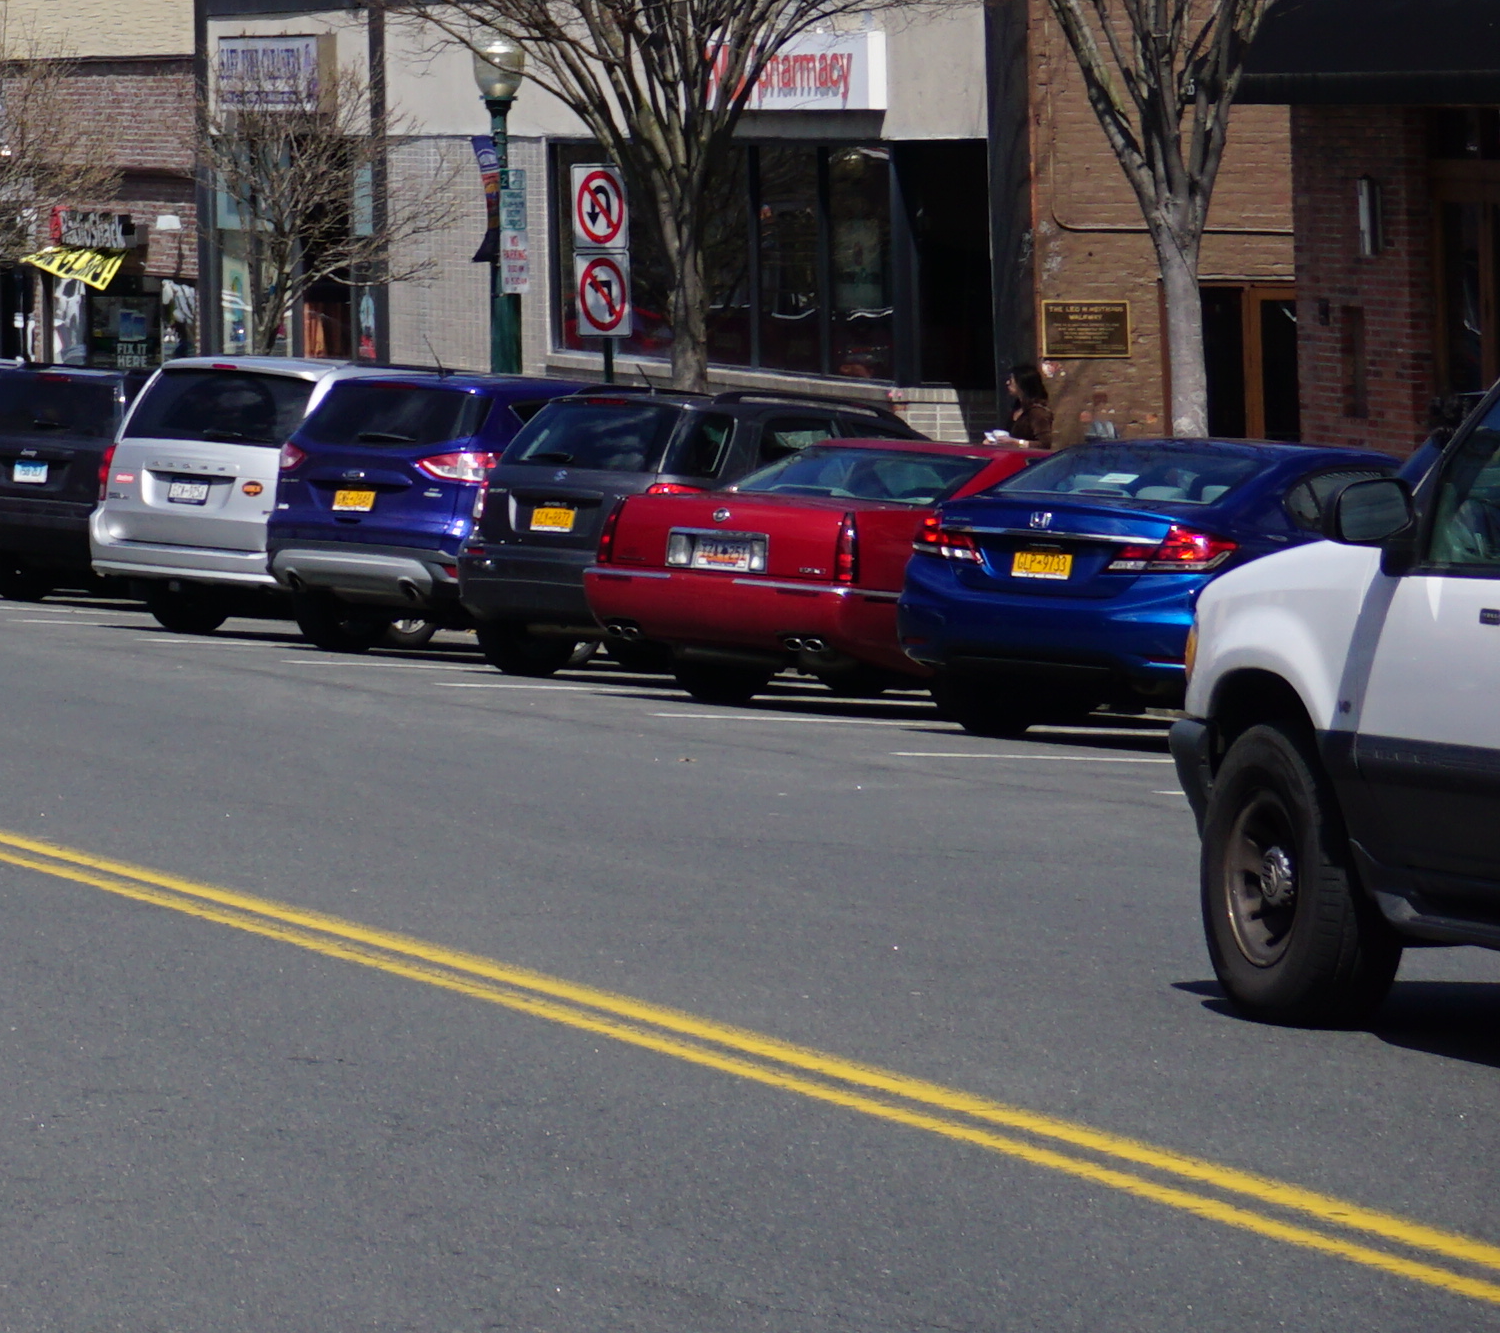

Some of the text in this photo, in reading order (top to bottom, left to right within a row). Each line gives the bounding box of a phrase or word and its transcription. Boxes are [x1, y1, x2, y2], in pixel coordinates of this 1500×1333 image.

[758, 52, 853, 101] pharmacy
[117, 343, 147, 355] FIX IT
[117, 355, 147, 367] HERE
